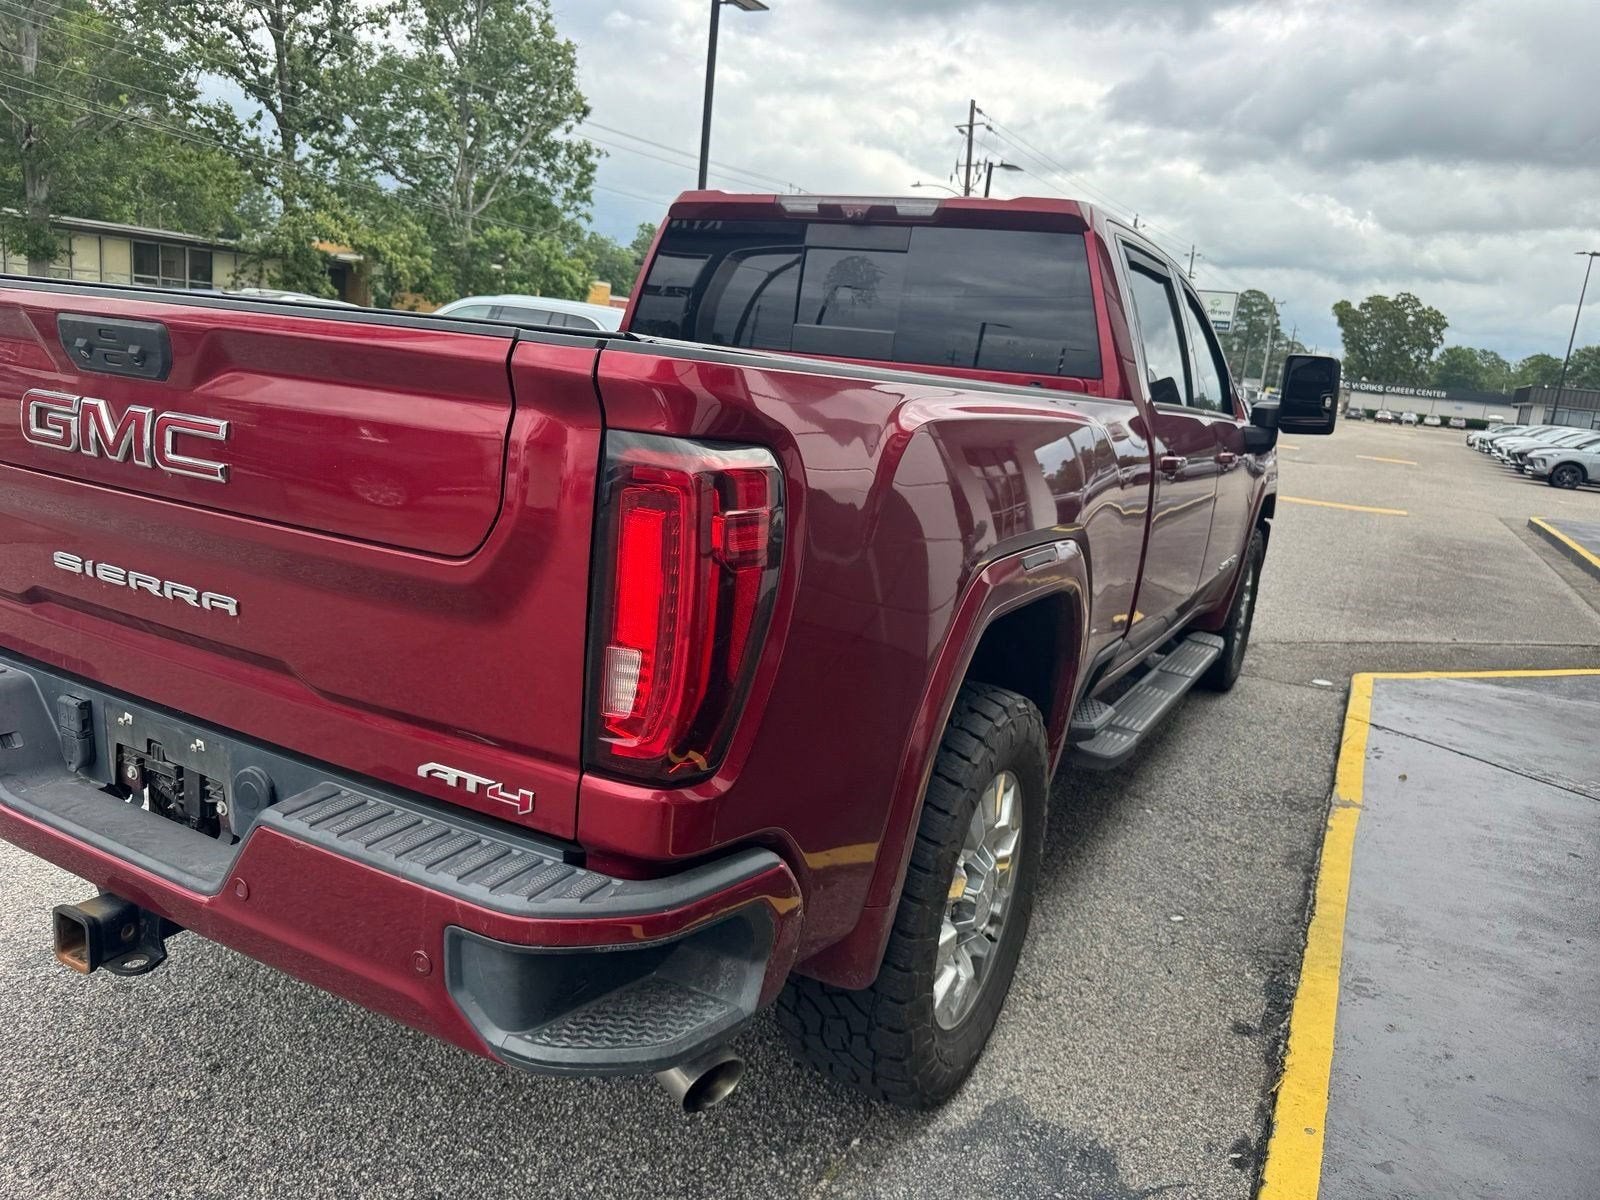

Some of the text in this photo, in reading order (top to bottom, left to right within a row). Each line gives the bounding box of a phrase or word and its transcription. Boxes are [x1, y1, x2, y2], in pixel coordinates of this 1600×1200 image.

[1351, 382, 1384, 392] WORKS
[1385, 385, 1415, 395] CAREER
[1416, 388, 1447, 398] CENTER
[20, 387, 230, 484] GMC
[53, 550, 239, 617] SIERRA
[417, 761, 536, 815] AT4
